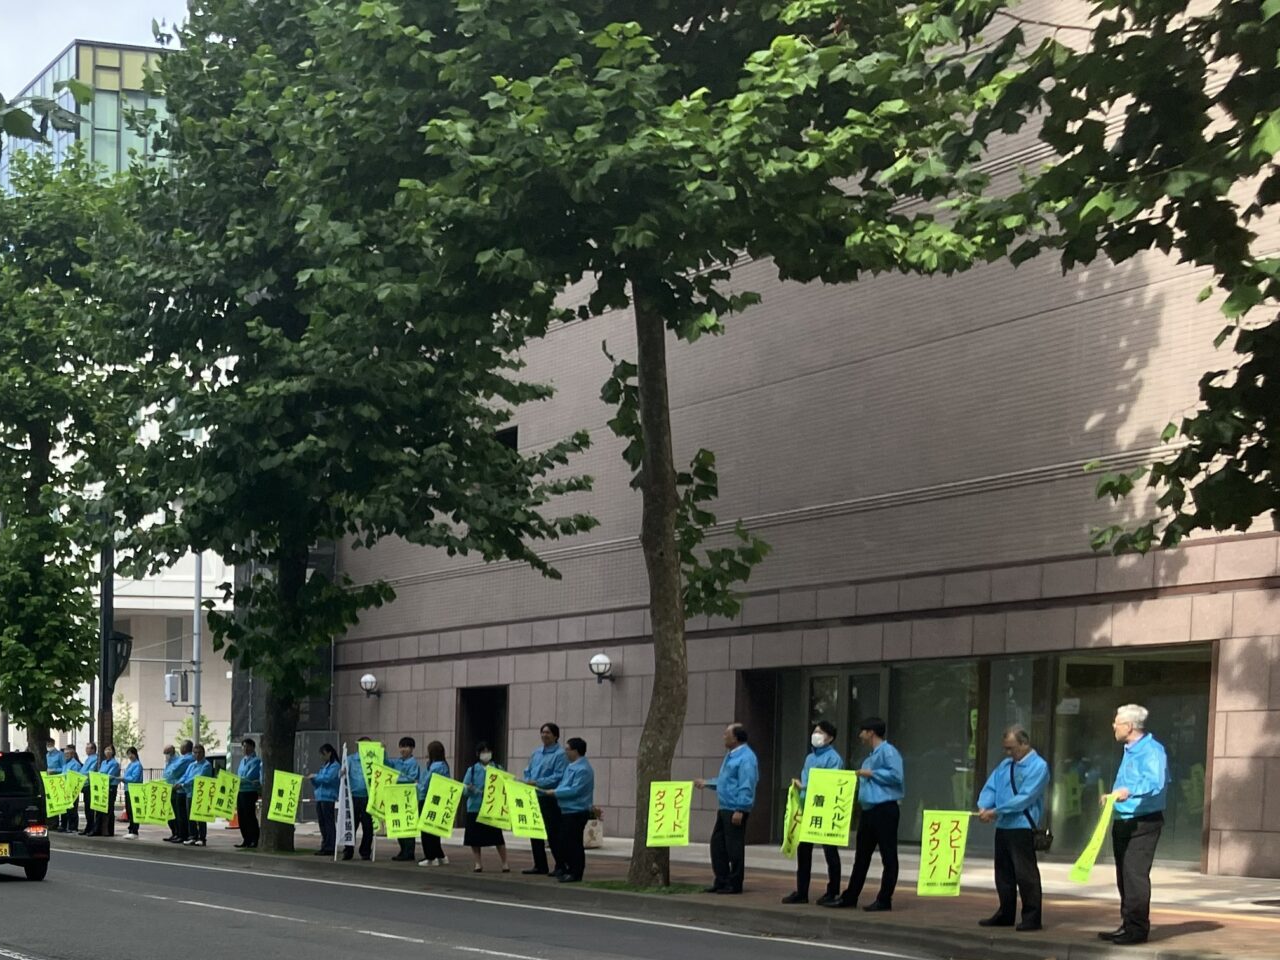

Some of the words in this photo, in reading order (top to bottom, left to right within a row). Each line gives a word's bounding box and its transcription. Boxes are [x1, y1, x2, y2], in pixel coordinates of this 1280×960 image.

[832, 779, 849, 830] シートベルト
[948, 820, 962, 879] スピード
